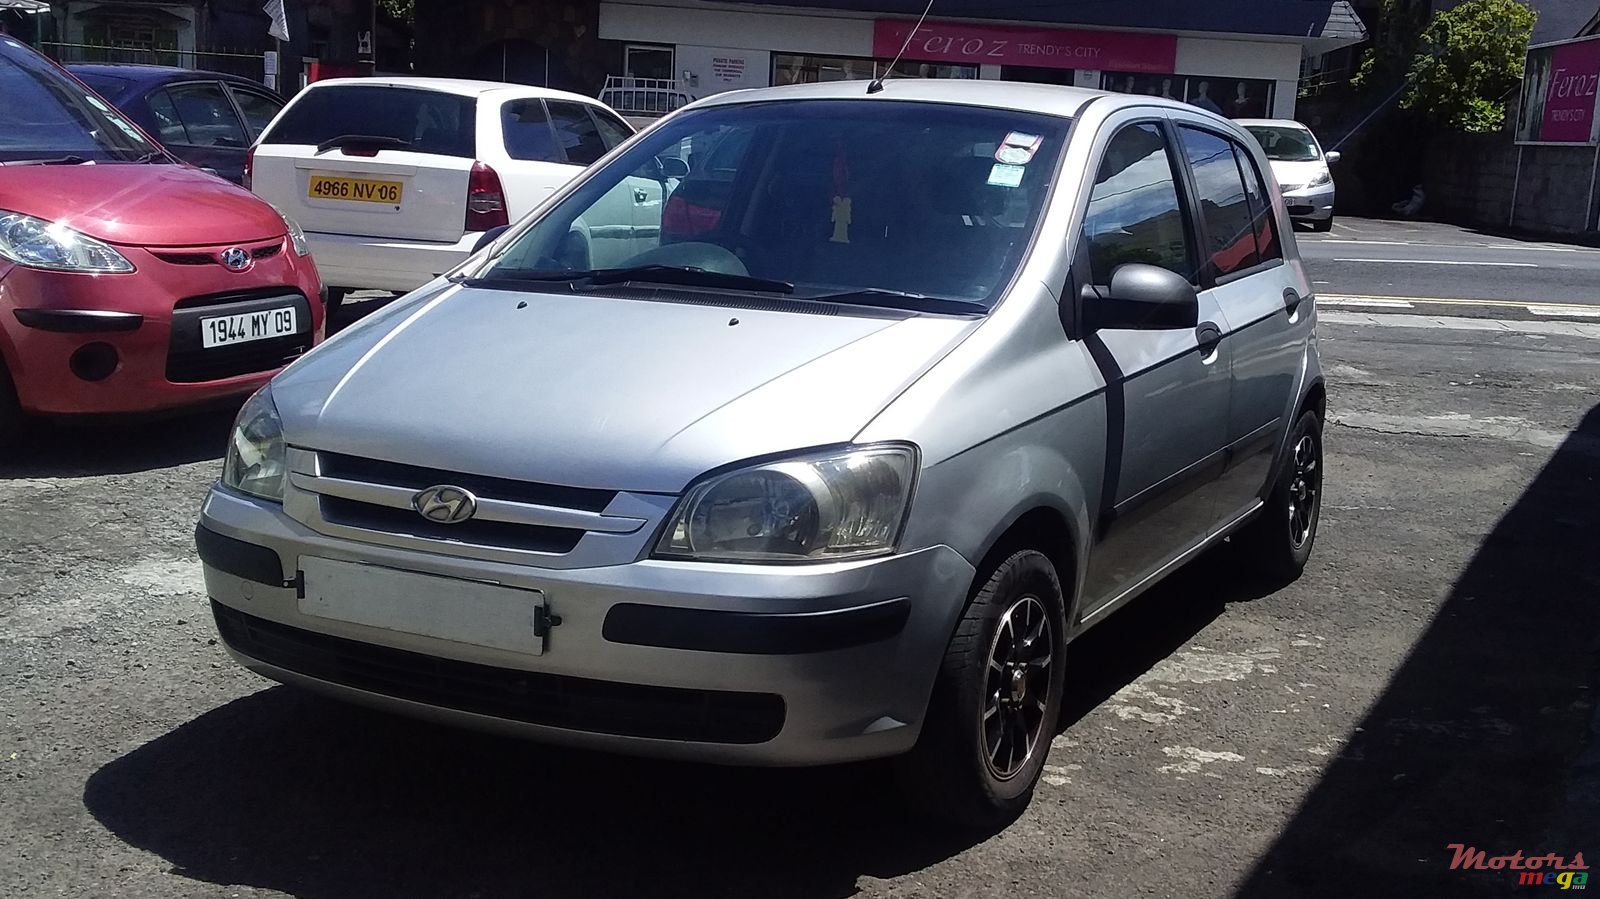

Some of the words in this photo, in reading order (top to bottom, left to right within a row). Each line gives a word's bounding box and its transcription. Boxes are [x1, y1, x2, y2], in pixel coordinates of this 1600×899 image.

[1017, 43, 1072, 57] TRENDY'S
[1075, 46, 1101, 57] CITY
[1548, 68, 1598, 102] Feroz
[314, 180, 349, 197] 4966
[353, 182, 376, 198] NV
[379, 185, 398, 201] 06
[209, 317, 246, 344] 1944
[251, 313, 269, 337] MY
[274, 310, 292, 333] 09
